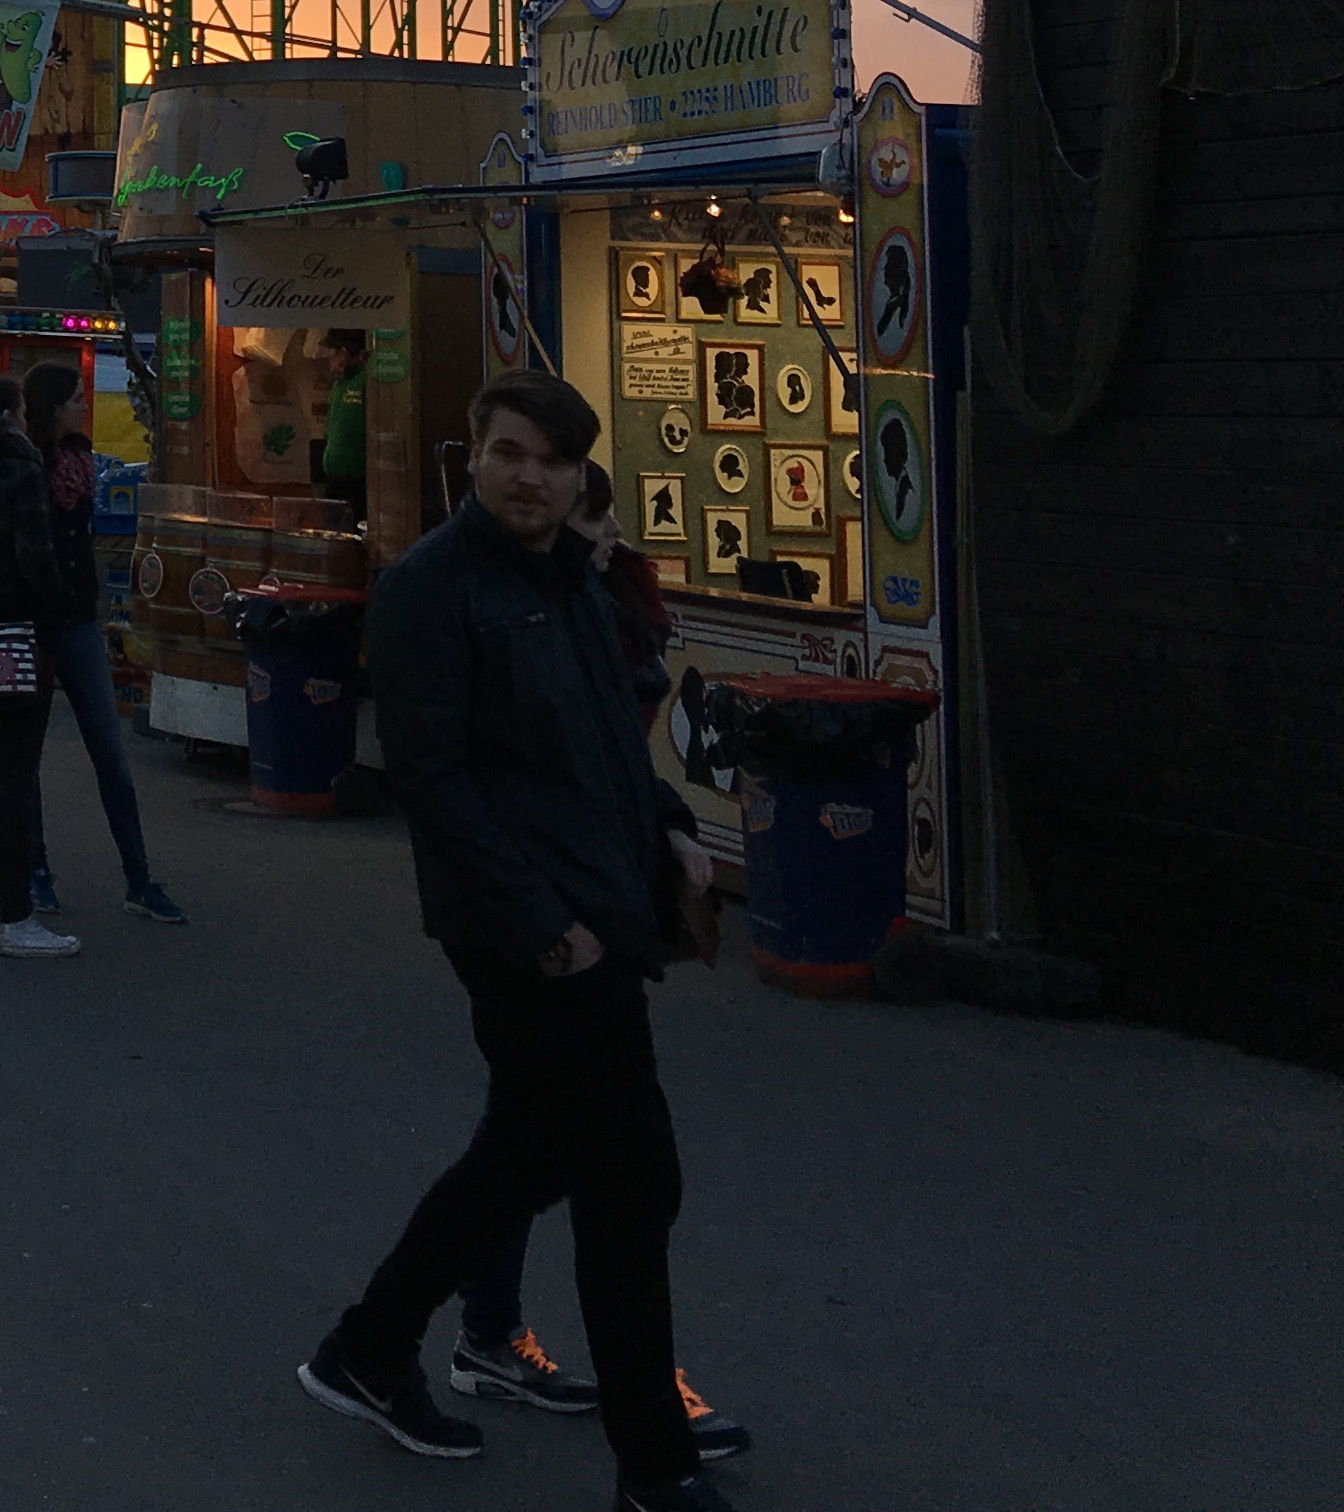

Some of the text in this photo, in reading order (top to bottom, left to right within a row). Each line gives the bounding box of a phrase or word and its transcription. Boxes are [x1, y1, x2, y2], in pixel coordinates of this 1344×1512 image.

[544, 0, 810, 94] Scherenschnitte
[545, 103, 617, 139] REINHOLD
[620, 96, 665, 125] STIER
[722, 72, 810, 113] HAMBURG
[301, 252, 345, 280] Der
[224, 276, 395, 310] Silhouetteur
